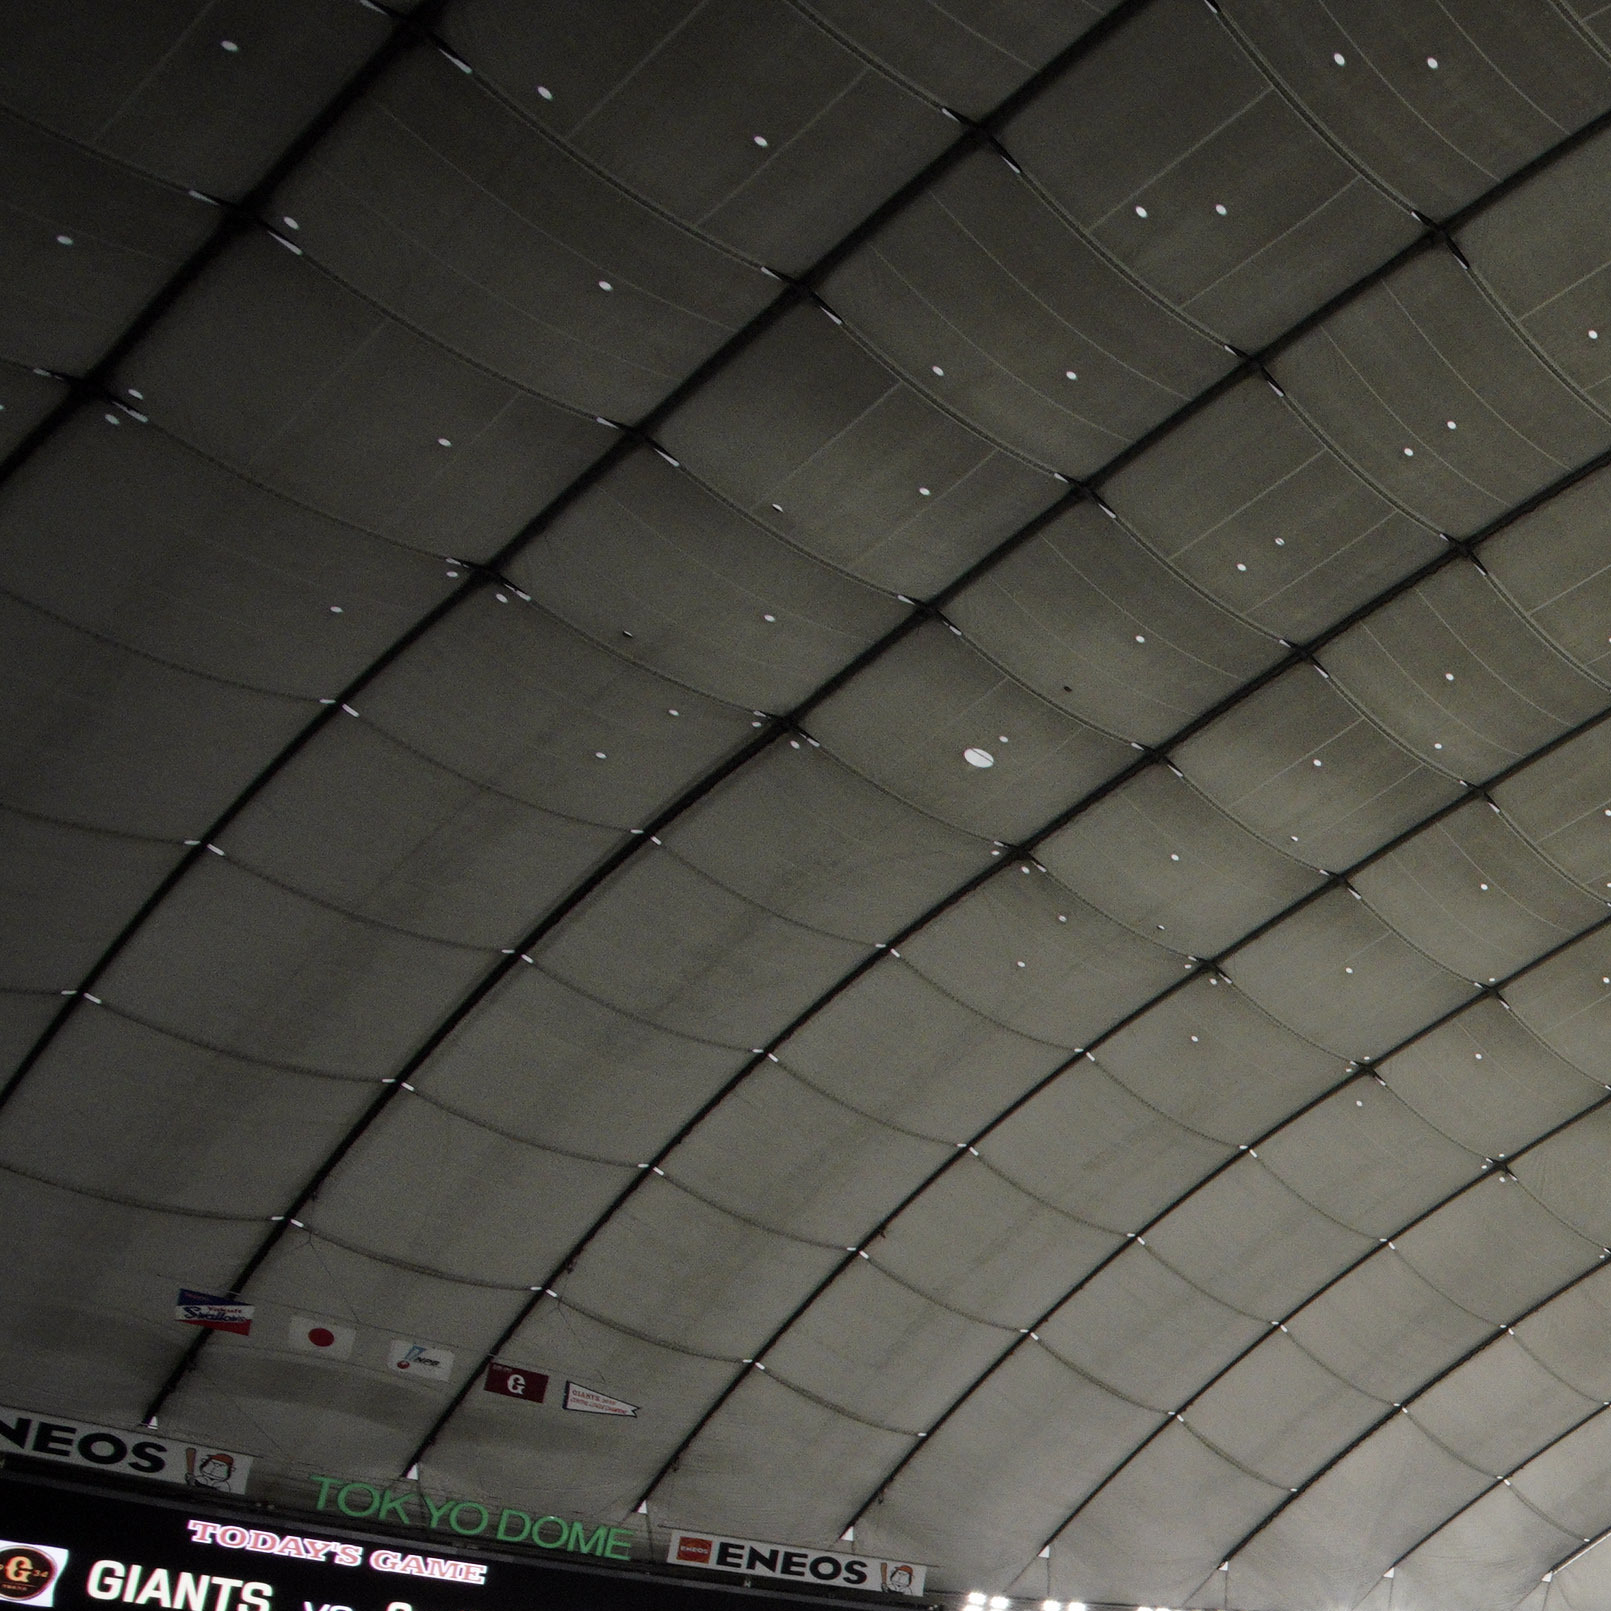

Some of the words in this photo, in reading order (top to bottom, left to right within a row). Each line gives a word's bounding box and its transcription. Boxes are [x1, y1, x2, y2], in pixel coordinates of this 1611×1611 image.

[309, 1475, 489, 1535] TOKYO
[496, 1509, 637, 1561] DOME
[187, 1519, 362, 1567] TODAY'S
[369, 1549, 488, 1585] GAME
[716, 1541, 868, 1585] ENEOS
